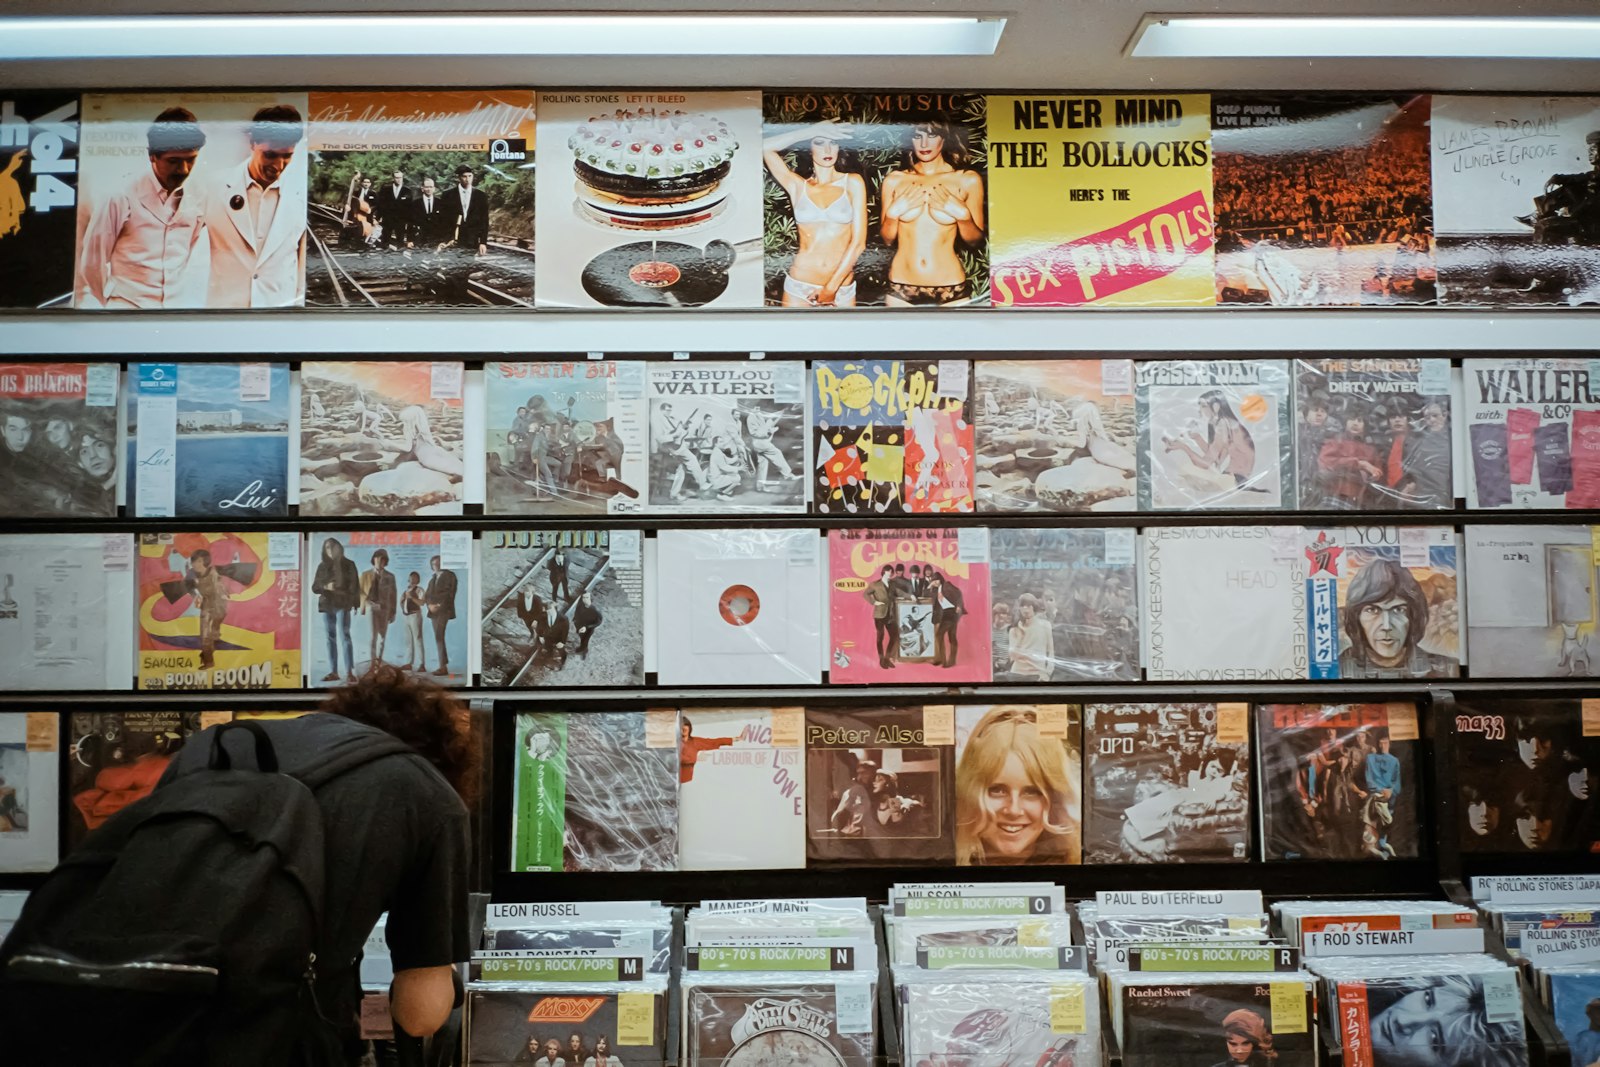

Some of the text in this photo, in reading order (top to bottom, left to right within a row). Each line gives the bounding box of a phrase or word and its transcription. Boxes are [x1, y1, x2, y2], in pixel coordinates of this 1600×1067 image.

[542, 95, 619, 103] ROLLING STONES
[626, 95, 686, 103] LET IT BLEED
[784, 94, 963, 112] ROXY MUSIC
[1013, 100, 1182, 130] NEVER MIND
[1216, 105, 1281, 114] DEEP PURPLE
[1216, 116, 1238, 126] LIVE
[1240, 116, 1251, 126] IN
[1438, 127, 1490, 150] JAMES
[989, 141, 1208, 168] THE BOLLOCKS
[1453, 144, 1558, 172] JUNGLE GROOVE
[1069, 189, 1131, 201] HERE'S THE
[585, 361, 617, 379] BIR
[1321, 360, 1420, 372] THE STANDELL
[671, 371, 773, 380] FABULOU
[1328, 381, 1420, 393] DIRTY WATER
[219, 479, 278, 508] Lui
[495, 531, 610, 549] BLUE THING
[1354, 527, 1400, 545] YOU
[1225, 569, 1278, 589] HEAD
[1315, 583, 1331, 660] ニール・ヤング
[144, 657, 193, 669] SAKURA
[165, 671, 209, 686] BOOM
[213, 660, 273, 686] BOOM
[807, 724, 933, 747] Peter Also
[712, 751, 752, 766] LABOUR
[754, 751, 767, 765] OF
[1497, 882, 1535, 892] ROLLING
[1538, 881, 1574, 891] STONES
[1576, 880, 1600, 890] (JAPA
[906, 899, 960, 911] 60's-70's
[962, 897, 1026, 910] ROCK/POPS
[1105, 892, 1223, 905] PAUL BUTTERFIELD
[493, 903, 580, 918] LEON RUSSEL
[772, 901, 809, 913] MANN
[1324, 932, 1415, 946] ROD STEWART
[1527, 930, 1567, 940] ROLLING
[701, 947, 848, 964] 60's-70's ROCK/POPS N
[929, 946, 1074, 963] 60's-70's ROCK/POPS P
[1143, 947, 1292, 965] 60's-70's ROCK/POPS R
[1537, 943, 1577, 954] ROLLING
[1116, 950, 1126, 963] Q
[484, 958, 637, 975] 60's-70's ROCK/POPS M
[1128, 987, 1191, 997] Rachel Sweet
[536, 999, 602, 1016] MOXY
